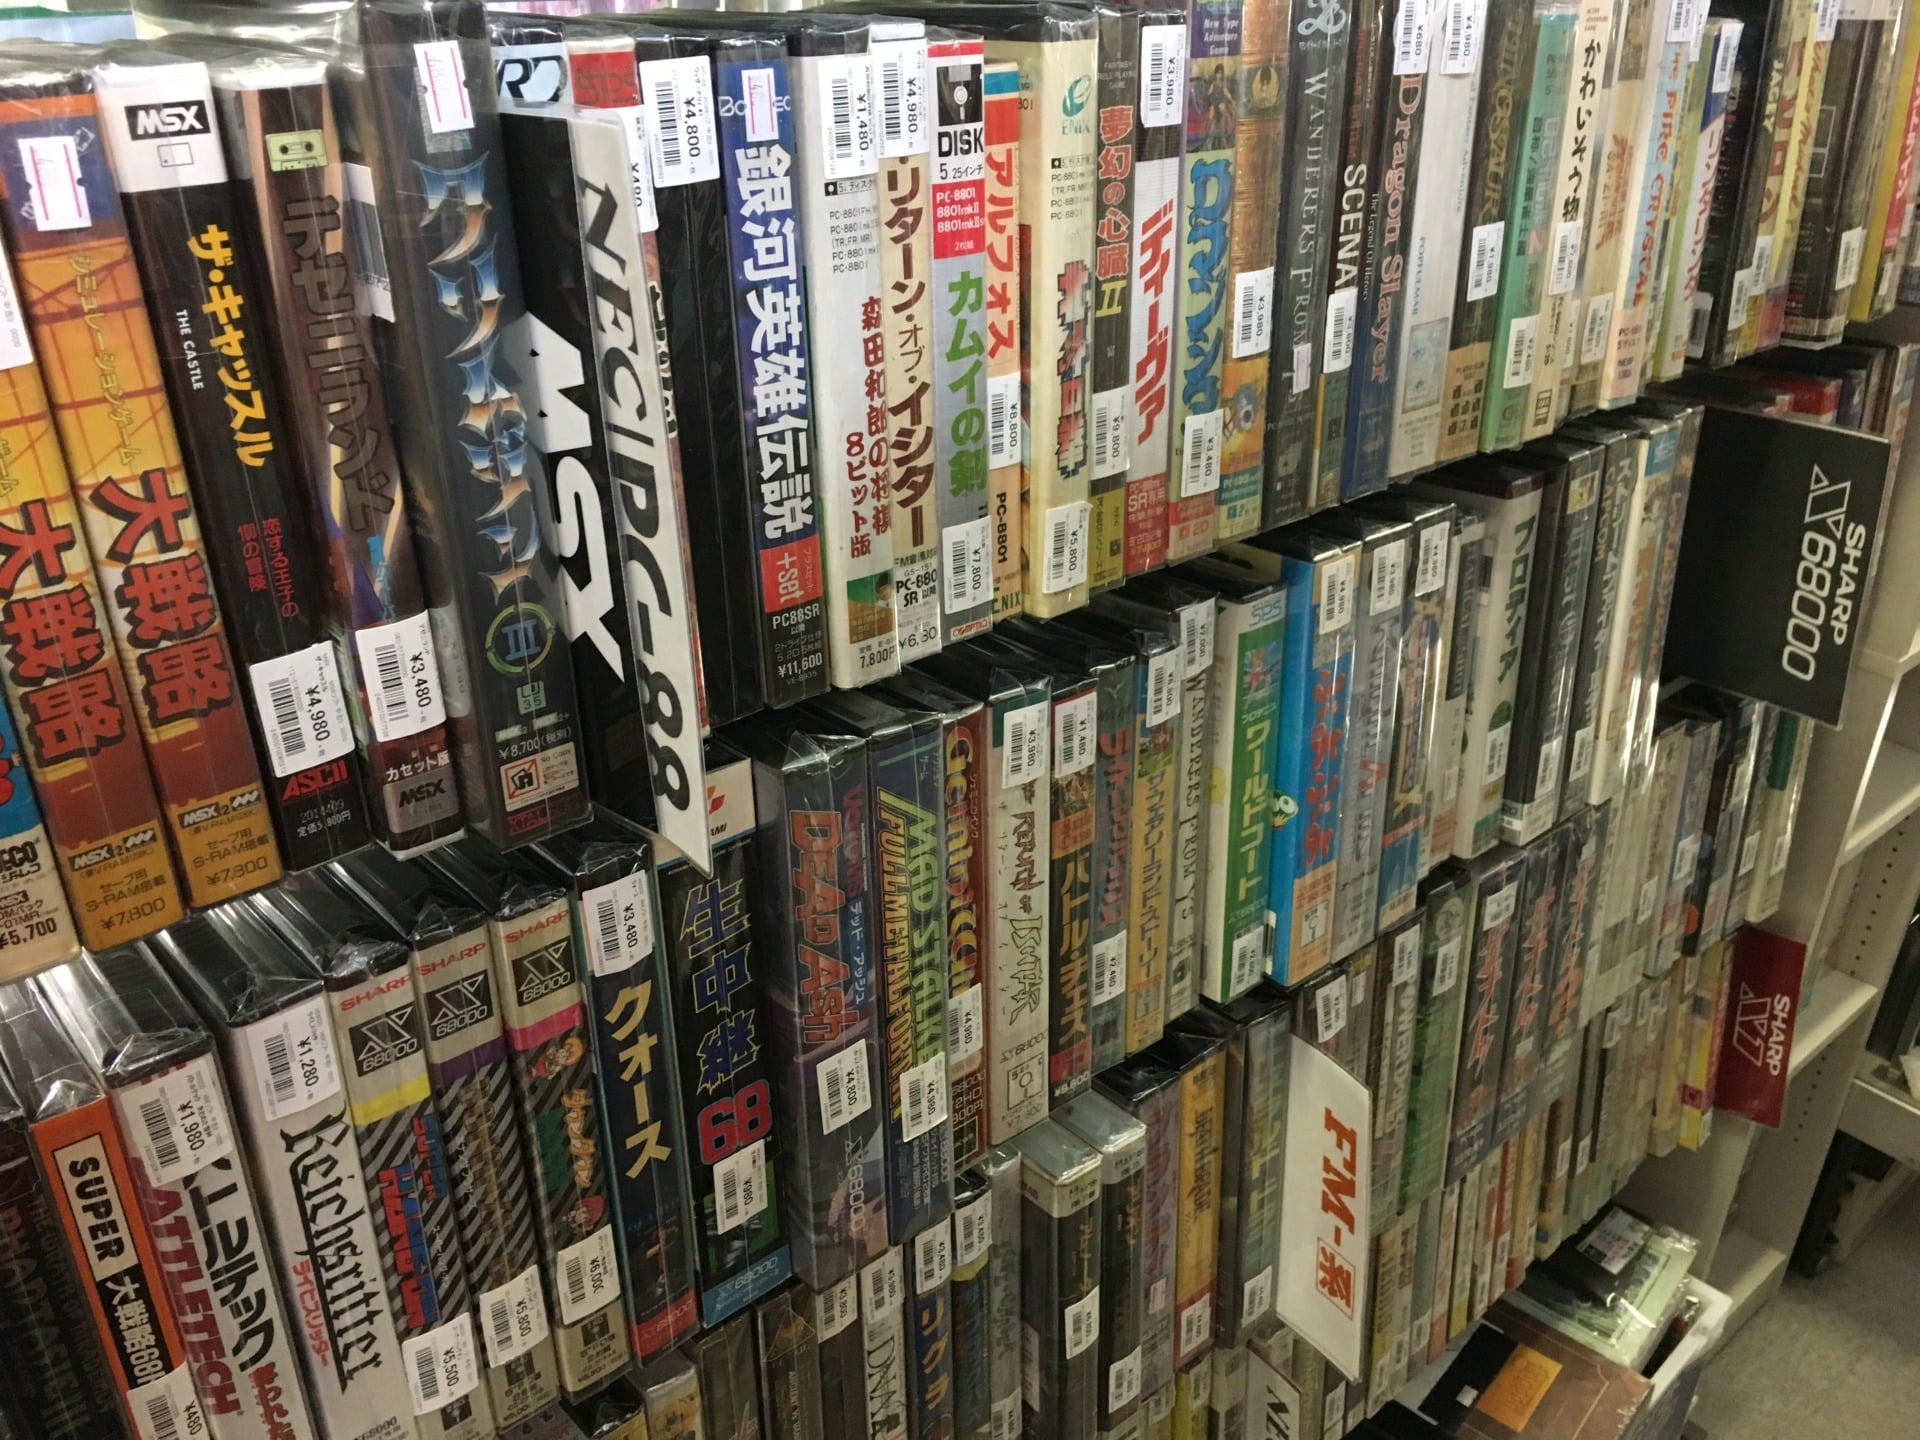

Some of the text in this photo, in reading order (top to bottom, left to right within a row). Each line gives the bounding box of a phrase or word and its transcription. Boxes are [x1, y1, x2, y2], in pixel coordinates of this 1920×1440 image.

[1414, 24, 1425, 57] ¥680
[1462, 14, 1474, 58] ¥4,980
[1164, 56, 1177, 106] ¥3,980
[137, 105, 204, 136] MSX
[683, 97, 701, 157] ¥4,800
[856, 93, 870, 151] ¥1,480
[905, 77, 919, 133] ¥4,980
[938, 128, 985, 158] DISK
[1299, 70, 1329, 254] WANDERERS
[1335, 163, 1367, 288] SCENA
[1367, 213, 1380, 248] Legend
[1370, 73, 1421, 384] Dragon Slayer
[832, 262, 868, 275] PC-8801
[1485, 246, 1496, 285] ¥1,980
[1254, 295, 1266, 338] ¥3,980
[68, 254, 142, 466] シミュレーションゲーム
[174, 308, 204, 391] THE CASTLE
[187, 223, 274, 467] ザ・キャッスル
[735, 143, 814, 540] 銀河英雄伝説
[946, 271, 987, 498] カムイの剣
[861, 295, 891, 535] 森田和郎の将棋
[1007, 402, 1019, 448] ¥8,800
[1111, 414, 1121, 459] ¥9,800
[1203, 436, 1215, 477] ¥3,480
[524, 310, 627, 684] MSX
[845, 431, 872, 559] 8ビット版
[996, 492, 1008, 566] PC-8801
[1068, 528, 1079, 572] ¥5,800
[971, 547, 984, 591] ¥7,800
[1833, 521, 1867, 646] SHARP
[88, 467, 233, 729] 大戦略
[772, 603, 821, 630] PC88SR
[410, 651, 434, 709] ¥3,480
[777, 652, 823, 678] ¥11,600
[305, 683, 332, 743] ¥4,980
[1027, 728, 1037, 768] ¥3,980
[1077, 718, 1087, 757] ¥1,480
[281, 759, 349, 802] ASCII
[385, 750, 451, 783] カセット版
[181, 803, 220, 827] MSX
[399, 778, 447, 809] MSX
[71, 843, 112, 870] MSX
[191, 833, 270, 870] S-RAM搭載
[206, 827, 254, 851] セーブ用
[84, 873, 167, 914] S-RAM搭載
[99, 868, 149, 894] セーブ用
[99, 897, 167, 931] ¥7,800
[503, 908, 571, 945] SHARP
[621, 903, 639, 949] ¥3,480
[415, 941, 488, 978] SHARP
[847, 901, 867, 1006] デッド・アッシュ
[339, 972, 412, 1012] SHARP
[963, 1009, 973, 1045] ¥4,980
[1766, 992, 1791, 1077] SHARP
[297, 1035, 320, 1089] ¥1,280
[604, 979, 673, 1178] クォース
[844, 1069, 858, 1107] ¥4,800
[926, 1078, 936, 1118] ¥4,980
[177, 1100, 206, 1152] ¥1,980
[696, 1078, 774, 1166] 68
[68, 1156, 126, 1263] SUPER
[744, 1176, 754, 1206] ¥980
[278, 1099, 384, 1396] Reichsritter
[291, 1257, 330, 1367] ライヒスリッター
[516, 1297, 532, 1338] ¥5,800
[443, 1345, 460, 1388] ¥5,500
[183, 1399, 203, 1435] ¥480
